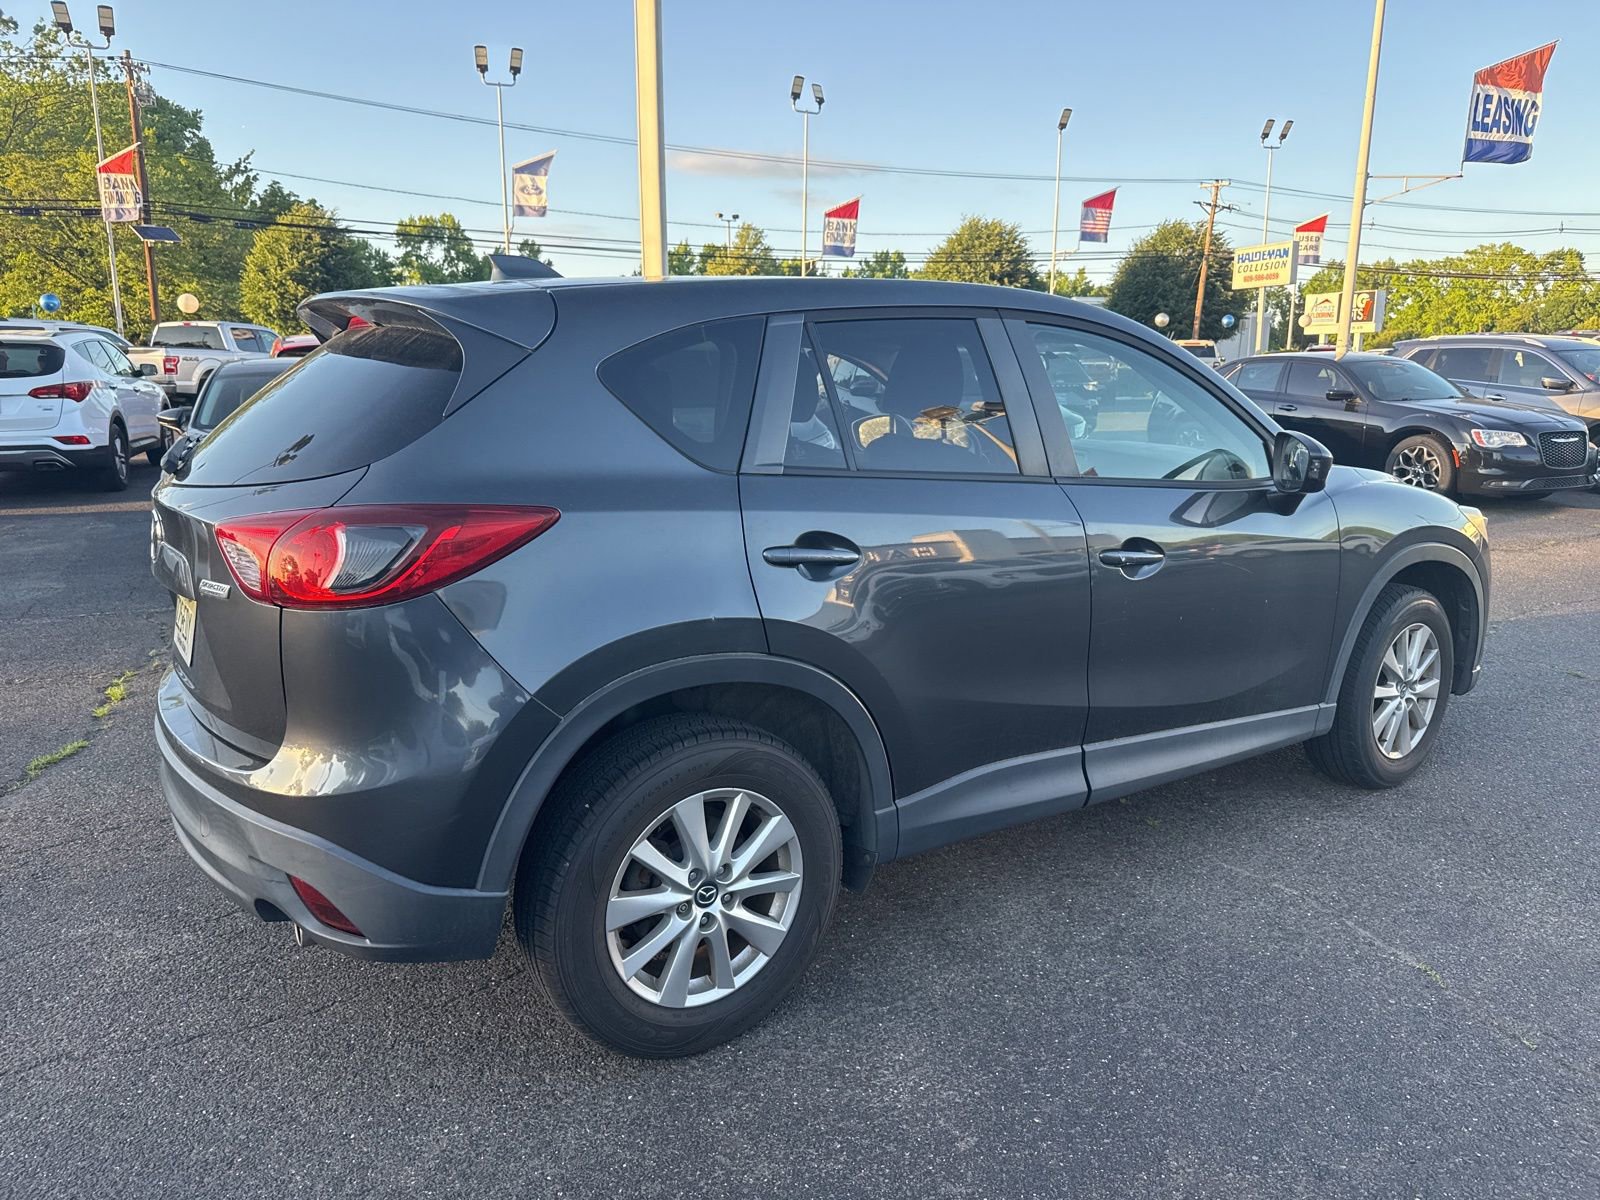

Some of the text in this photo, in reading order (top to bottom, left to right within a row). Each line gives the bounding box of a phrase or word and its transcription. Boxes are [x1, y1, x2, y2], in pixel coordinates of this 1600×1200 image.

[1472, 92, 1540, 138] LEASING
[103, 176, 137, 191] BANK
[827, 220, 857, 233] BANK
[1237, 247, 1290, 264] HALDEMAN
[1237, 260, 1288, 273] COLLISION
